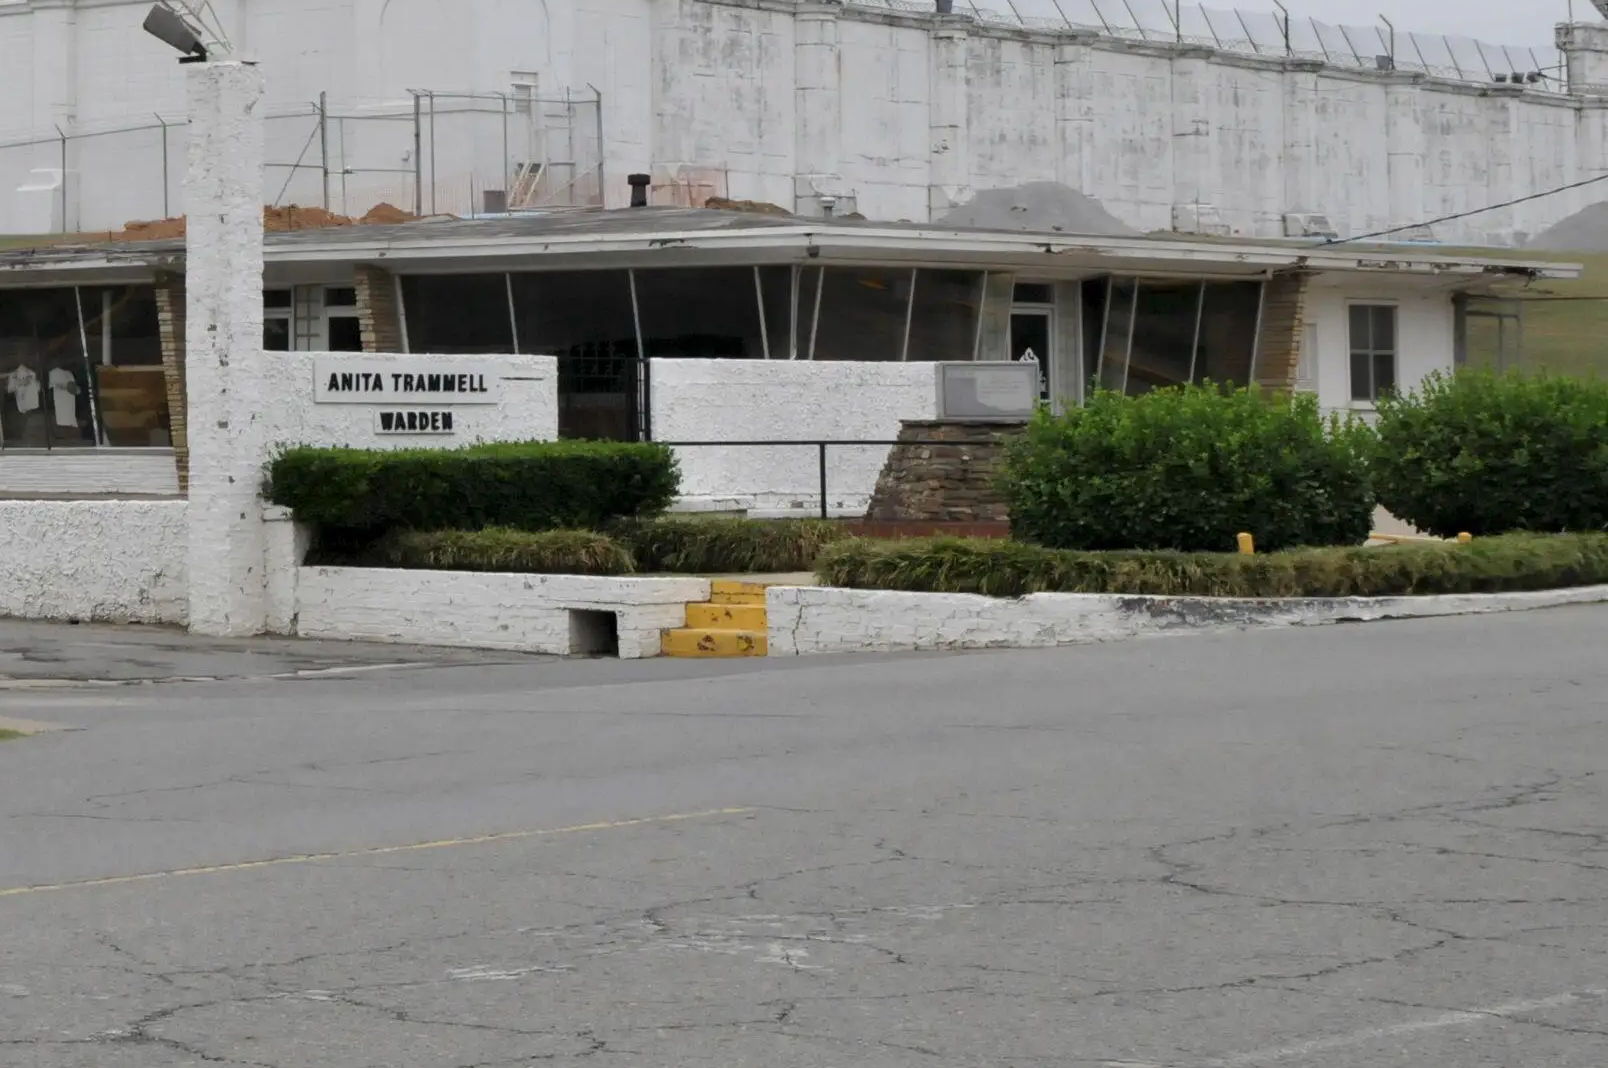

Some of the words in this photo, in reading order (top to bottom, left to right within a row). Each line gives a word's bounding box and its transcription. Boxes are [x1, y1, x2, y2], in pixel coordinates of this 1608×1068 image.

[328, 373, 383, 392] ANITA
[392, 373, 488, 393] TRAMMELL
[380, 412, 453, 431] WARDEN
